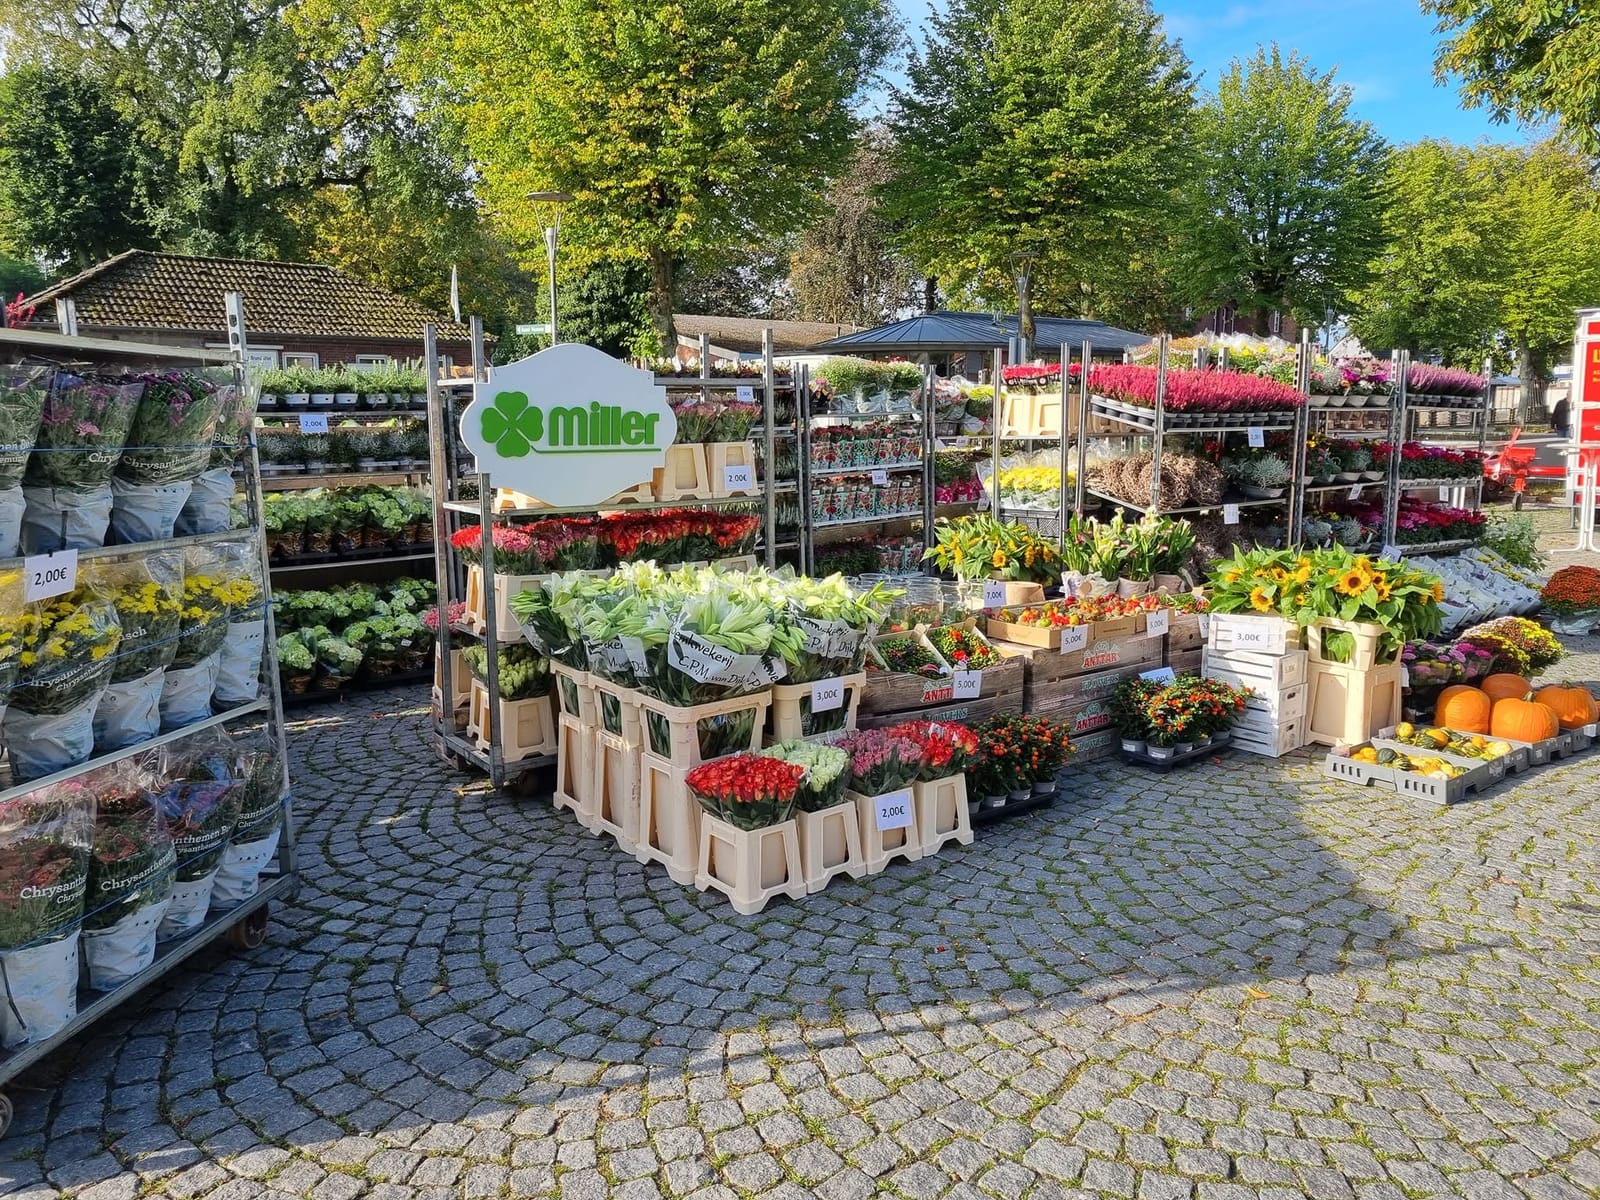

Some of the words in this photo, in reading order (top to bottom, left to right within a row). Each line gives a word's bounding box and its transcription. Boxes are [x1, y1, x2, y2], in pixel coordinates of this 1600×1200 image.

[548, 400, 660, 446] miller
[34, 567, 68, 587] 2,00€
[1064, 634, 1083, 646] 5,00€
[1237, 632, 1261, 642] 3,00€
[958, 680, 976, 689] 5,00€
[816, 689, 838, 701] 3,00€
[882, 805, 905, 818] 2,00€
